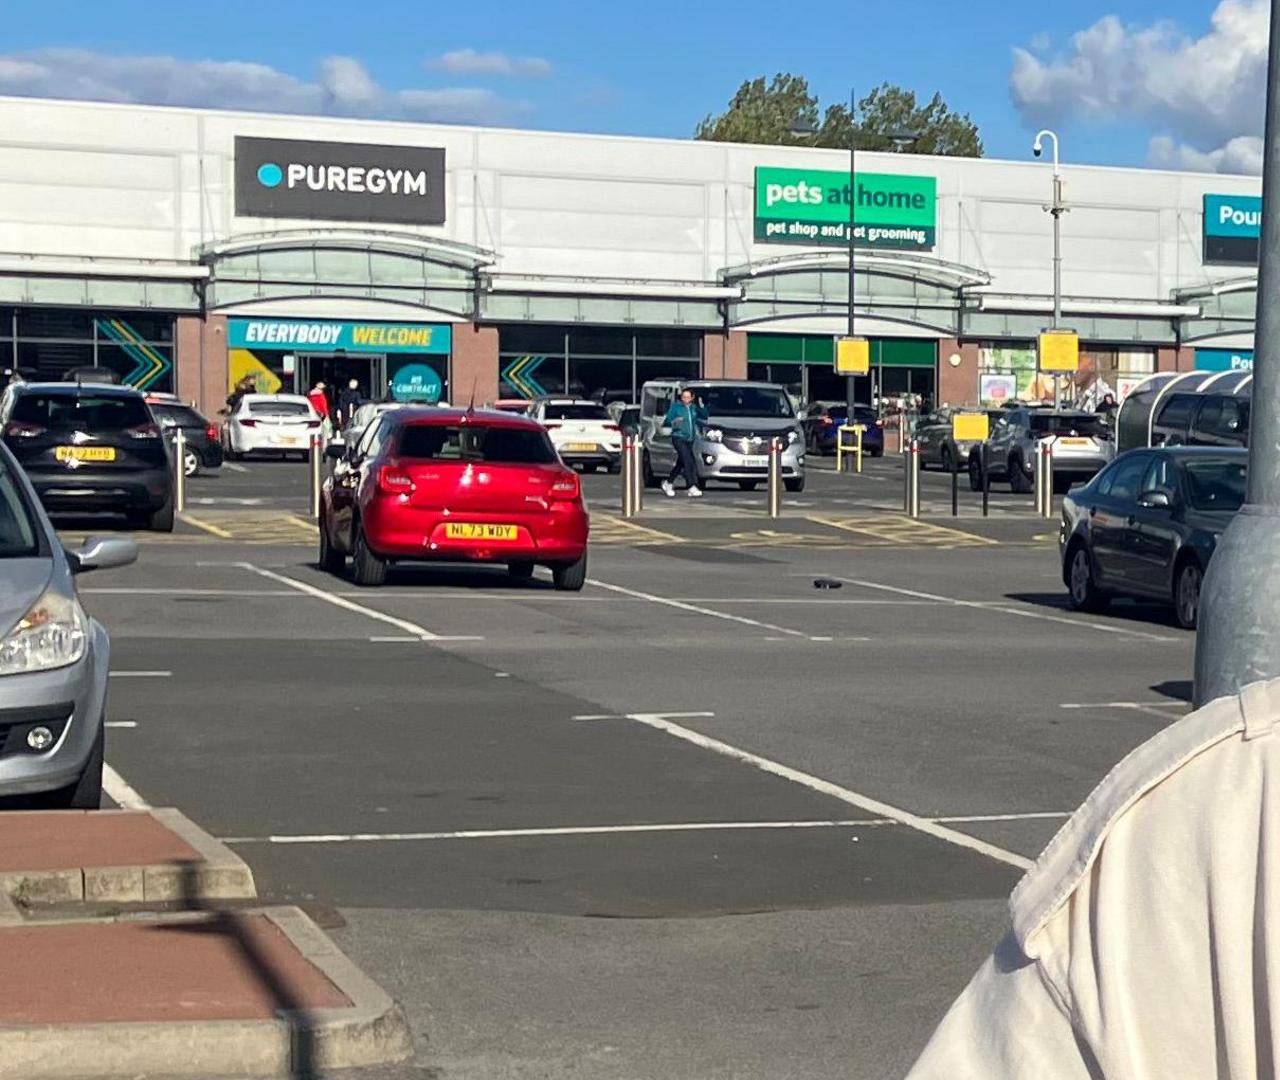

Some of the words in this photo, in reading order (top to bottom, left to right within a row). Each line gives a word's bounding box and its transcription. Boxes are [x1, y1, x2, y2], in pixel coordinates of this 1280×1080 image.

[287, 163, 427, 196] PUREGYM
[766, 180, 823, 206] pets
[827, 183, 851, 205] at
[858, 184, 926, 210] home
[766, 222, 786, 236] pet
[788, 222, 819, 238] shop
[821, 223, 844, 237] and
[846, 226, 866, 239] et
[868, 227, 926, 243] grooming
[245, 322, 343, 344] EVERYBODY
[352, 326, 433, 346] WELCOME
